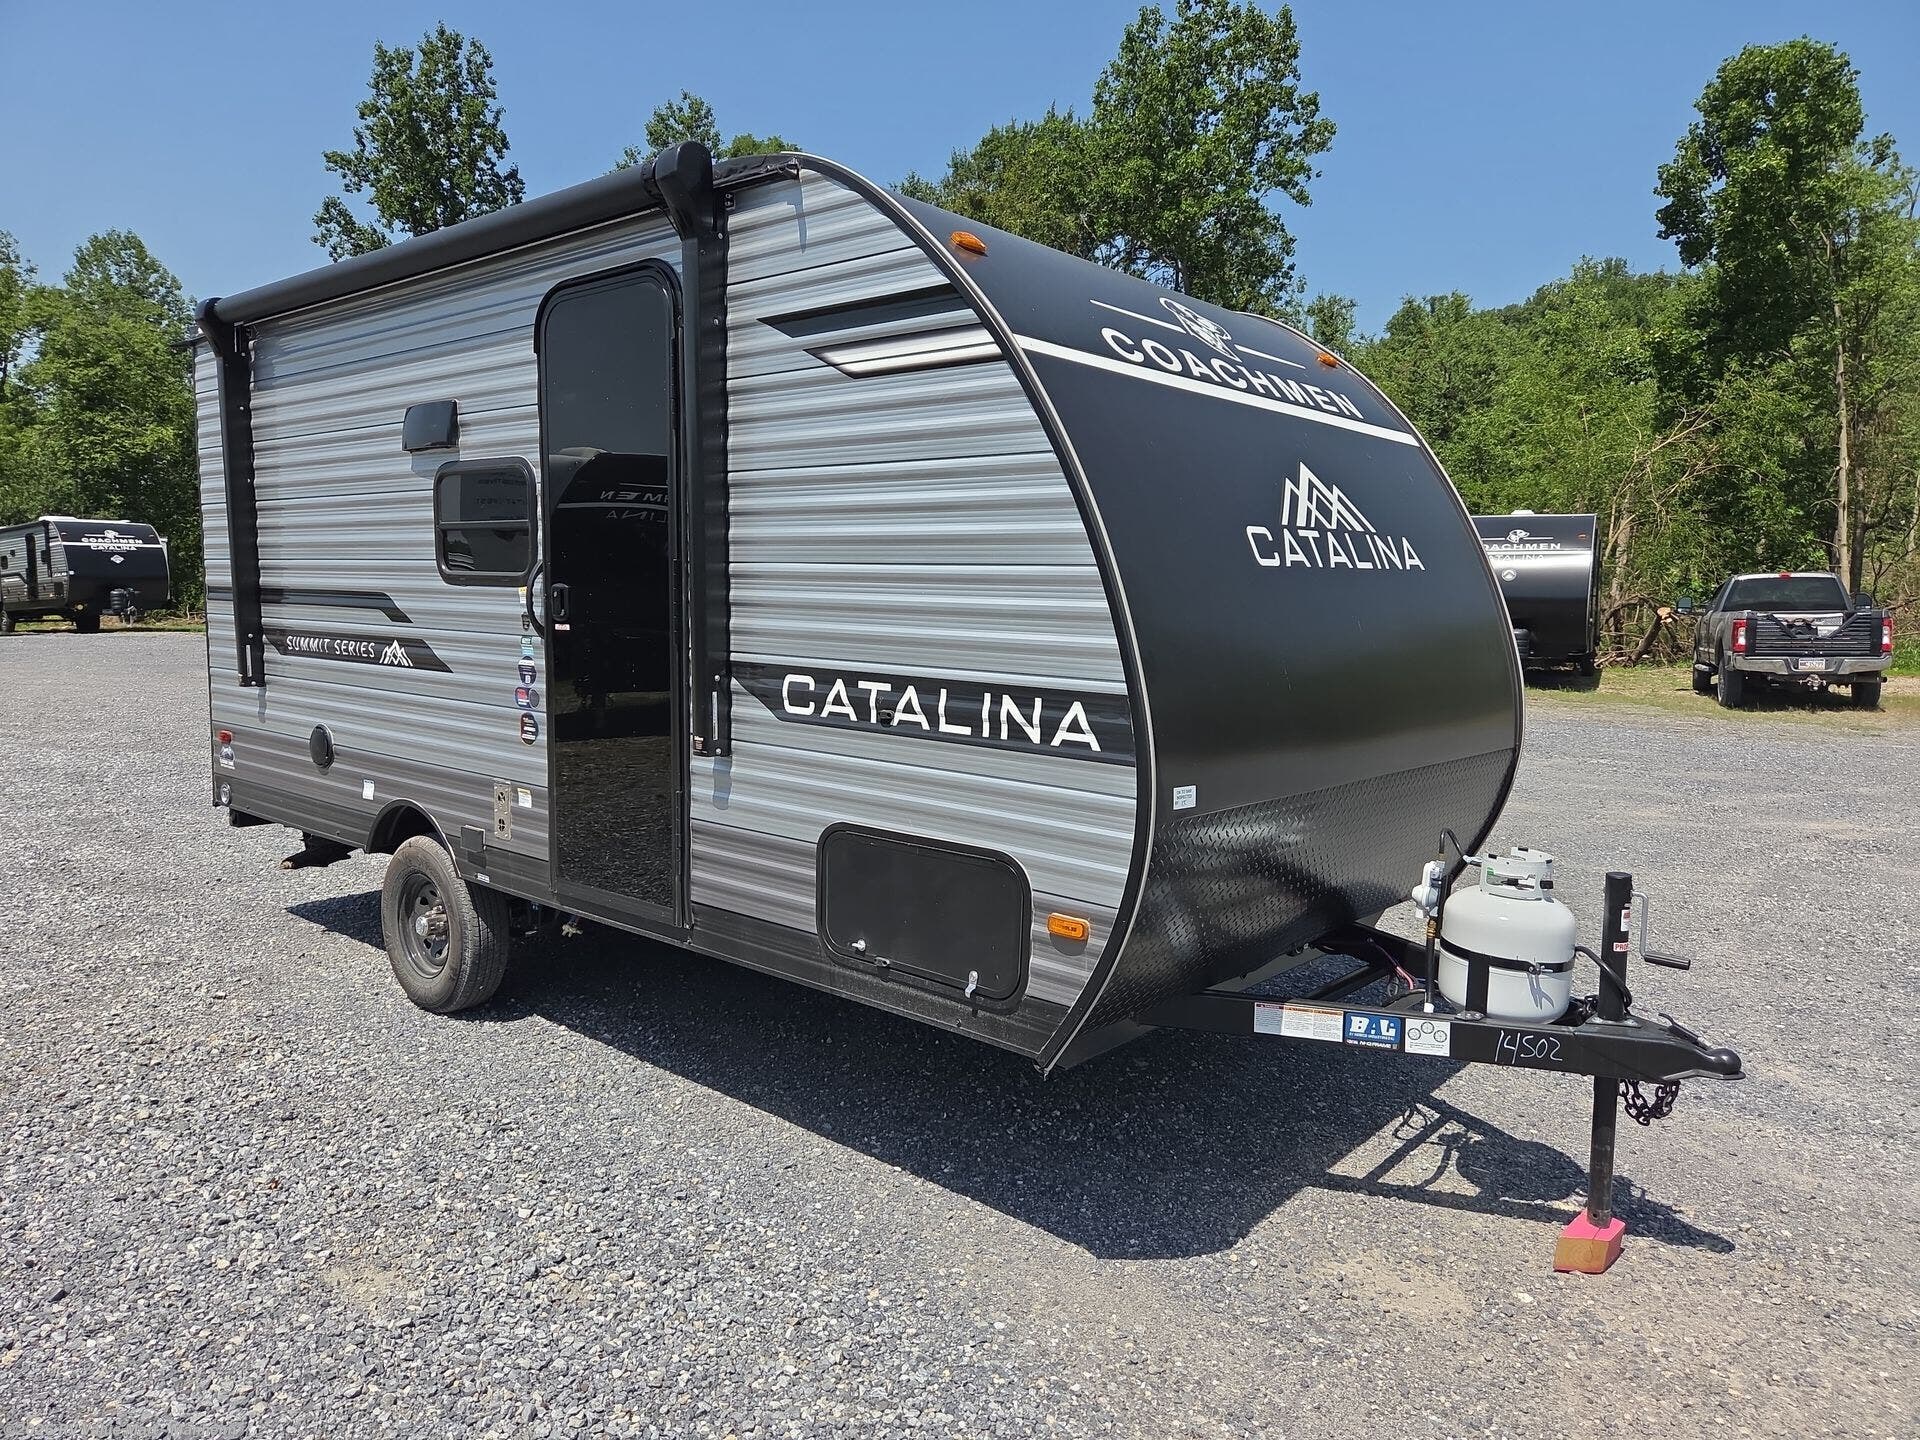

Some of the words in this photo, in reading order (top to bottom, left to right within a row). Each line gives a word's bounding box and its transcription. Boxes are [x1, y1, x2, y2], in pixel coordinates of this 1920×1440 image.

[1101, 327, 1364, 419] COACHMEN
[90, 543, 138, 551] CATALINA
[1246, 525, 1426, 571] CATALINA
[286, 635, 331, 653] SUMMIT
[334, 640, 375, 658] SERIES
[781, 673, 1102, 752] CATALINA
[1494, 1030, 1563, 1065] 14502
